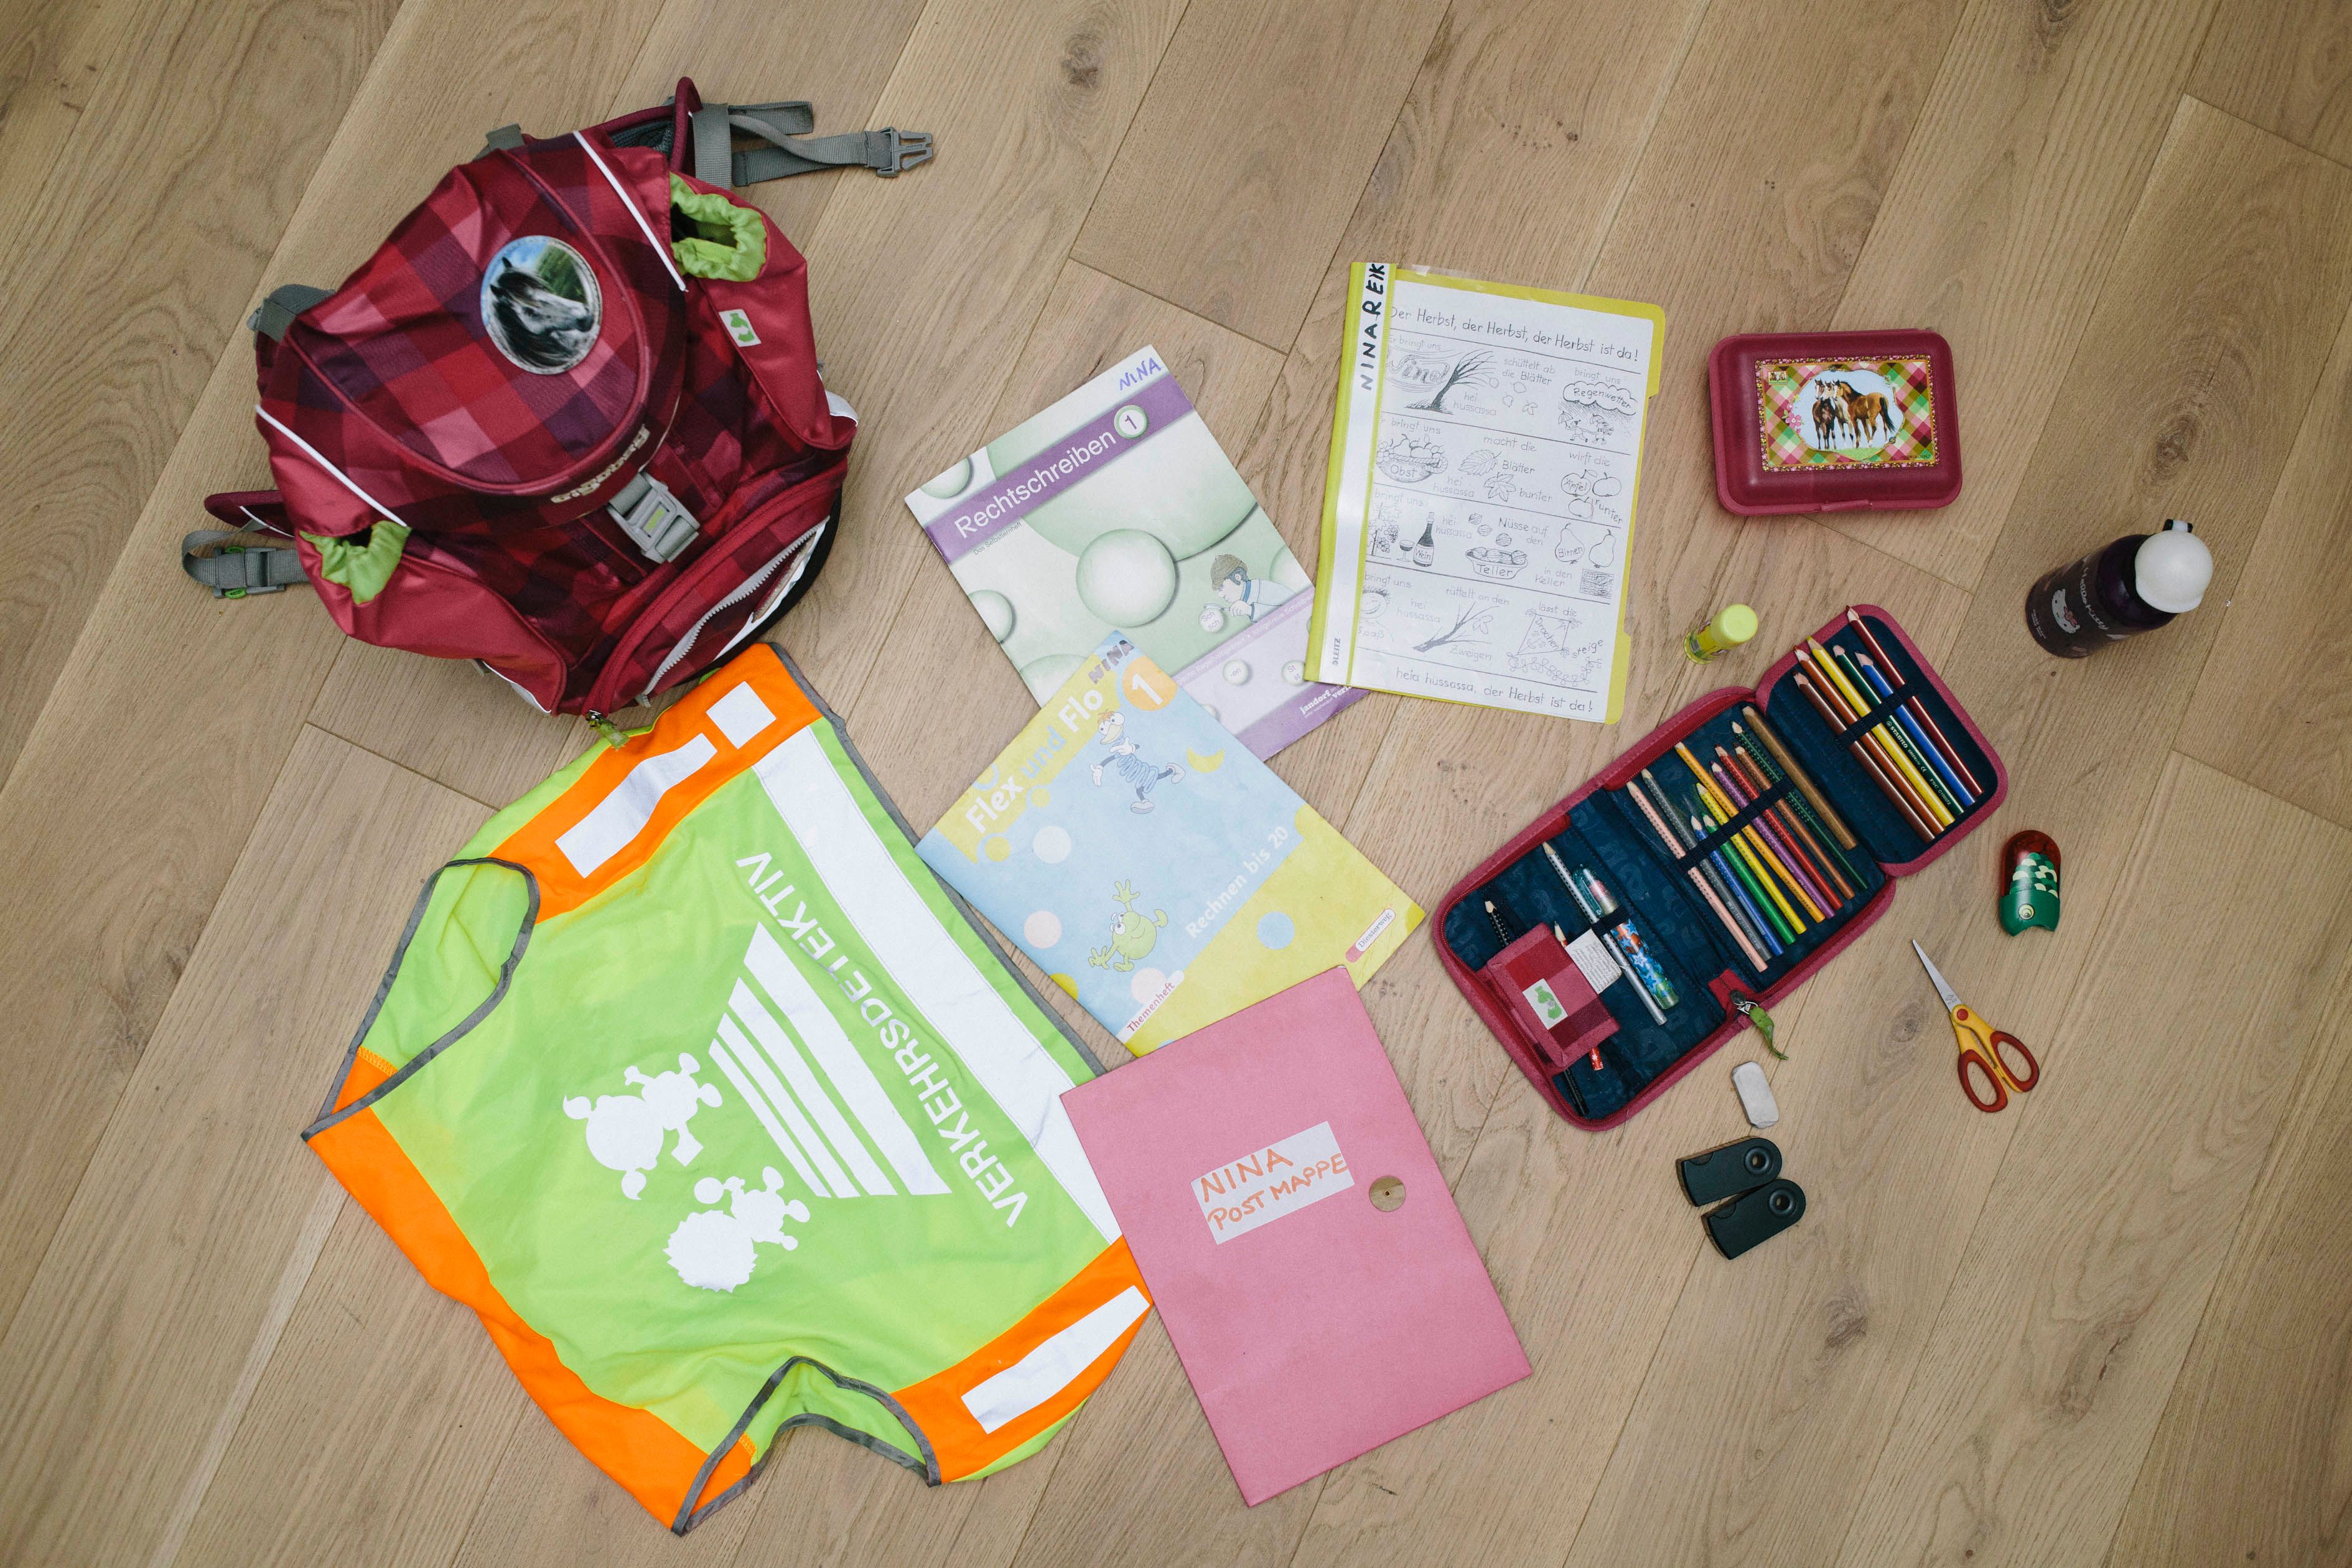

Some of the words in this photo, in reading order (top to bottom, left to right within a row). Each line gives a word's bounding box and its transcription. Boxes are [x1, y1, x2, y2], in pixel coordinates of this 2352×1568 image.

[1417, 309, 1456, 330] Herbst,
[1462, 319, 1483, 332] der
[1487, 322, 1528, 342] Herbst,
[1533, 331, 1552, 344] der
[1555, 334, 1595, 352] Herbst
[1600, 343, 1615, 355] ist
[1399, 335, 1426, 350] bringt
[1504, 357, 1541, 370] schüttelt
[1543, 365, 1556, 373] ab
[1119, 357, 1162, 391] NINA
[1502, 370, 1514, 378] die
[1521, 371, 1552, 386] Blätter
[1574, 367, 1602, 381] bringt
[1605, 375, 1622, 384] uns
[1464, 391, 1478, 403] hei
[1573, 387, 1631, 409] Regenwetter
[1453, 401, 1497, 416] hussassa
[1391, 418, 1419, 432] bringt
[1424, 424, 1441, 434] uns
[1483, 436, 1518, 449] macht
[1520, 441, 1537, 452] die
[1502, 460, 1536, 475] Blätter
[1569, 452, 1592, 465] wirft
[1594, 457, 1610, 467] die
[954, 430, 1116, 539] Rechtschreiben
[1124, 413, 1139, 432] 1
[1390, 464, 1417, 478] Obst
[1447, 476, 1463, 486] hei
[1564, 477, 1587, 492] Äpfel
[1374, 488, 1404, 503] bringt
[1406, 497, 1424, 506] uns
[1433, 483, 1475, 498] hussassa
[1519, 488, 1552, 503] bunter
[1594, 499, 1623, 524] runter
[1442, 514, 1457, 526] hei
[1498, 517, 1529, 531] Nüsse
[1531, 526, 1549, 538] auf
[1435, 526, 1473, 539] hussassa
[1526, 536, 1543, 546] den
[1415, 549, 1431, 561] Wein
[1558, 548, 1583, 558] Birnen
[1477, 564, 1513, 577] Teller
[1556, 568, 1572, 579] den
[1364, 572, 1391, 587] bringt
[1394, 579, 1412, 589] uns
[1446, 587, 1475, 599] rüttelt
[1492, 595, 1509, 605] den
[1201, 611, 1215, 622] Sch
[1397, 607, 1441, 623] hussassa
[1538, 602, 1559, 614] lässt
[1563, 607, 1577, 617] die
[1208, 620, 1220, 630] sch
[1535, 617, 1559, 651] Drachen
[1450, 645, 1492, 661] Zweigen
[1573, 639, 1603, 658] steige
[1088, 639, 1134, 684] NINA
[1287, 665, 1295, 673] St
[1294, 673, 1302, 681] st
[1396, 666, 1419, 682] heia
[1484, 685, 1504, 698] der
[1509, 686, 1544, 705] Herbst
[1551, 697, 1566, 708] ist
[1299, 689, 1331, 715] jandorf
[1889, 726, 1908, 749] STABILO
[964, 776, 1024, 834] Flex
[1020, 724, 1066, 781] und
[1057, 689, 1103, 734] Flo
[1131, 673, 1164, 706] 1
[1185, 874, 1248, 939] Rechnen
[1243, 847, 1271, 875] bis
[1267, 826, 1289, 850] 20
[1357, 909, 1393, 949] Diesterweg
[1126, 980, 1176, 1032] Themenheft
[735, 852, 1028, 1228] VERKEHRSDETEKTIV
[1200, 1148, 1294, 1203] NINA
[1207, 1189, 1265, 1231] POST
[1269, 1152, 1349, 1202] MAPPE
